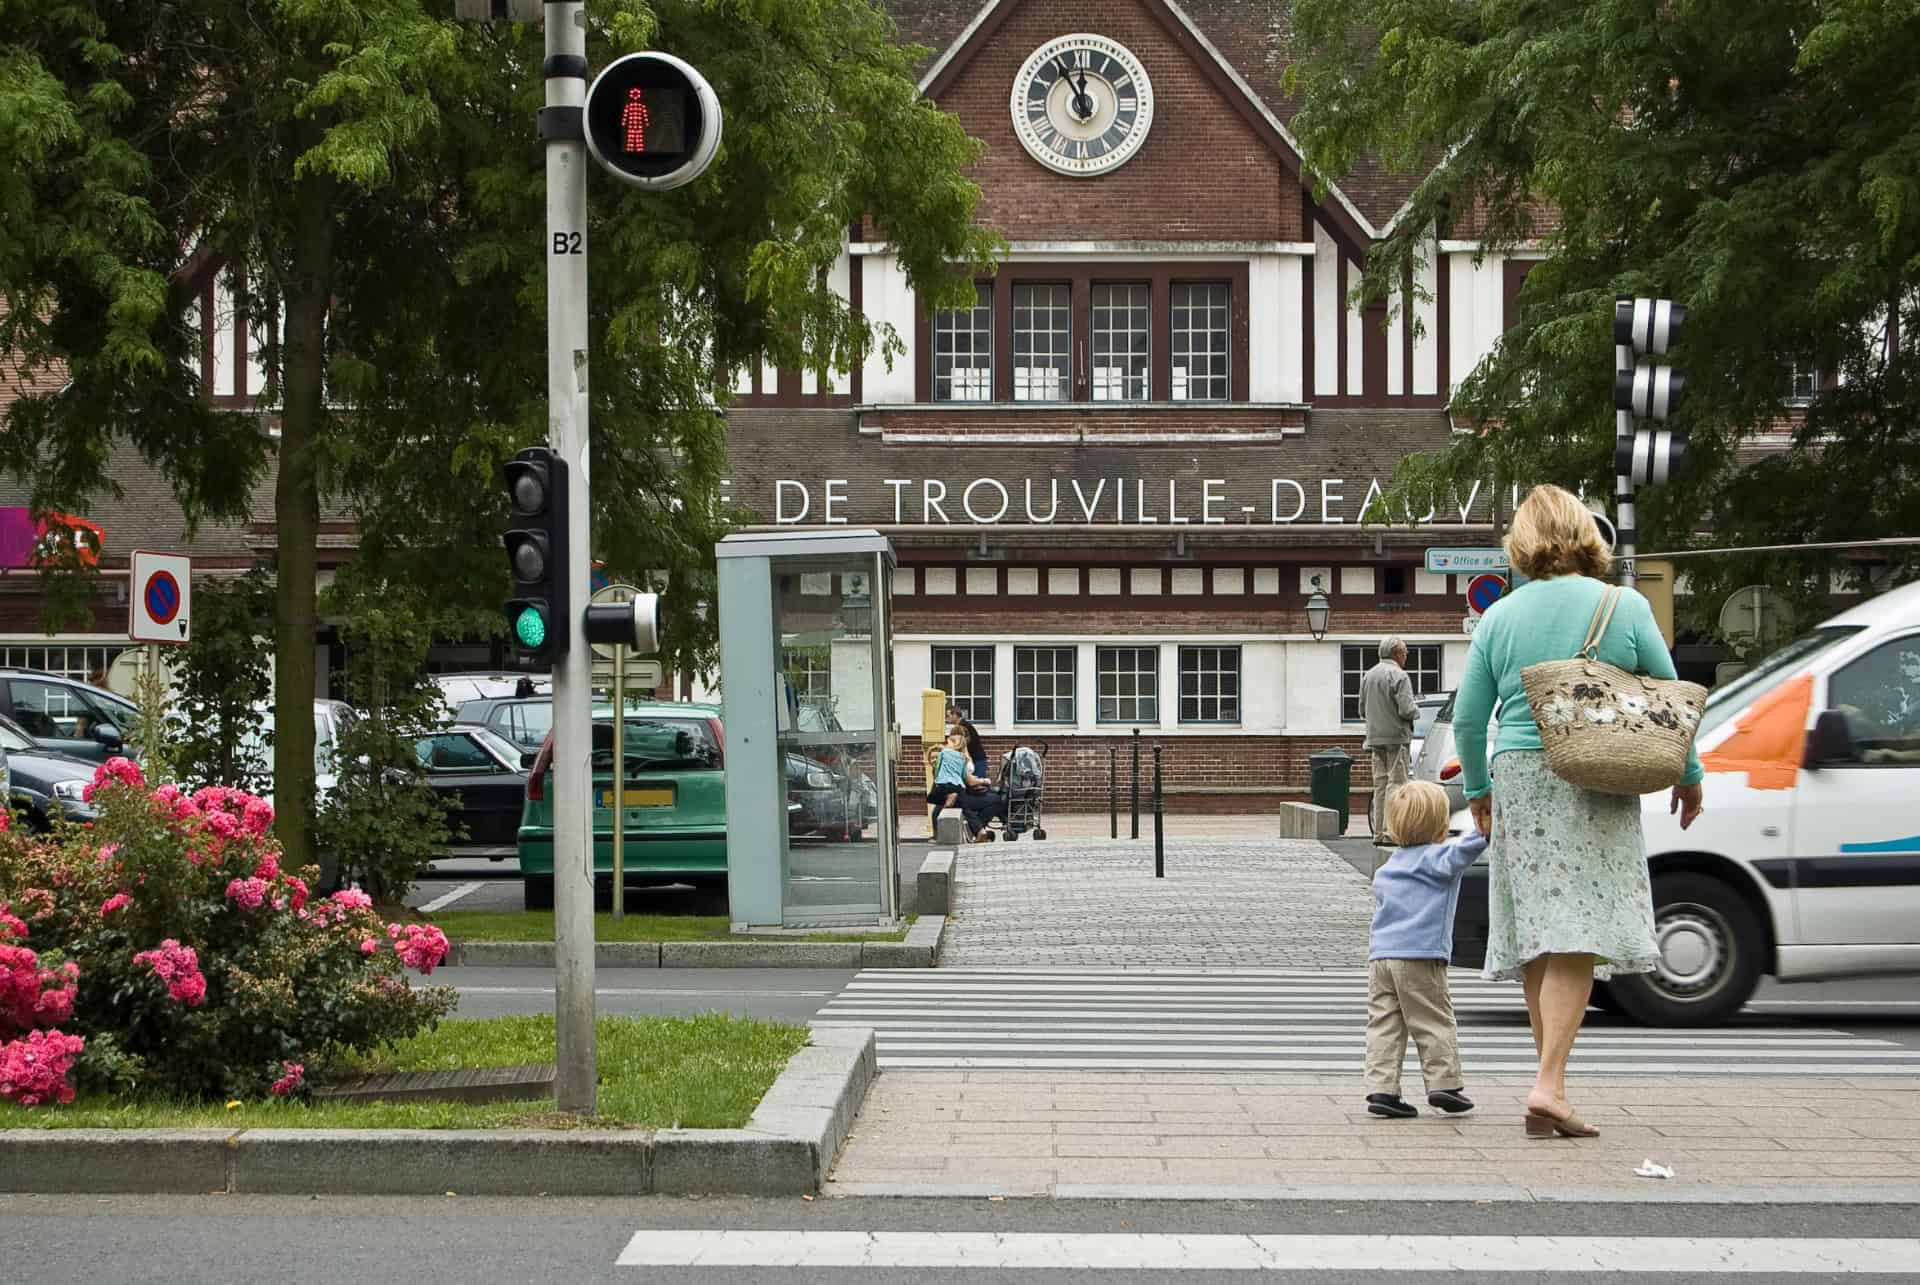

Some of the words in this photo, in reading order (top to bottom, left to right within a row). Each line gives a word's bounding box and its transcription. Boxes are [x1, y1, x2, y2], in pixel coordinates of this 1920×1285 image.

[553, 231, 583, 255] B2
[775, 479, 848, 524] DE
[1454, 555, 1479, 566] Office
